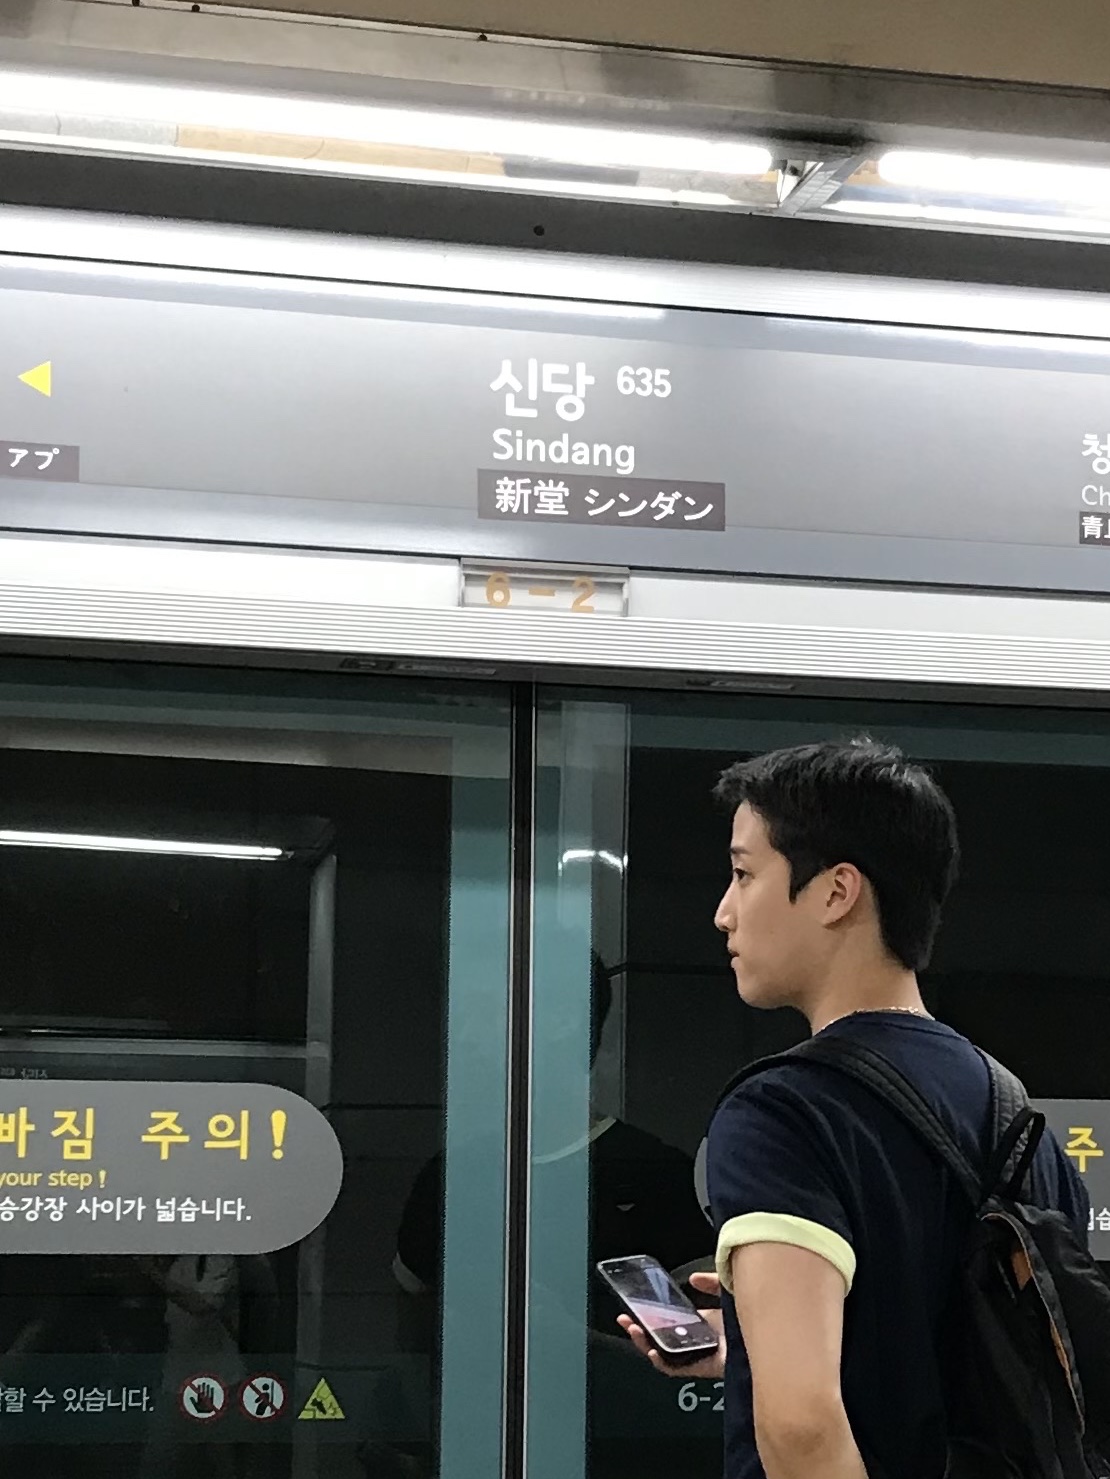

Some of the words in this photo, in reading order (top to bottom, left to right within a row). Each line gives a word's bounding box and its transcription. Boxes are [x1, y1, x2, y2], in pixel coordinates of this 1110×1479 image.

[489, 358, 596, 422] 신당
[616, 365, 673, 398] 635
[8, 447, 60, 470] アプ
[492, 428, 635, 475] Sindang
[495, 476, 570, 516] 新堂
[48, 1170, 93, 1190] step
[0, 1196, 68, 1222] 승강장
[76, 1196, 146, 1221] 사이가
[155, 1197, 252, 1222] 넓습니다.
[32, 1387, 56, 1412] 수
[63, 1387, 154, 1412] 있습니다.
